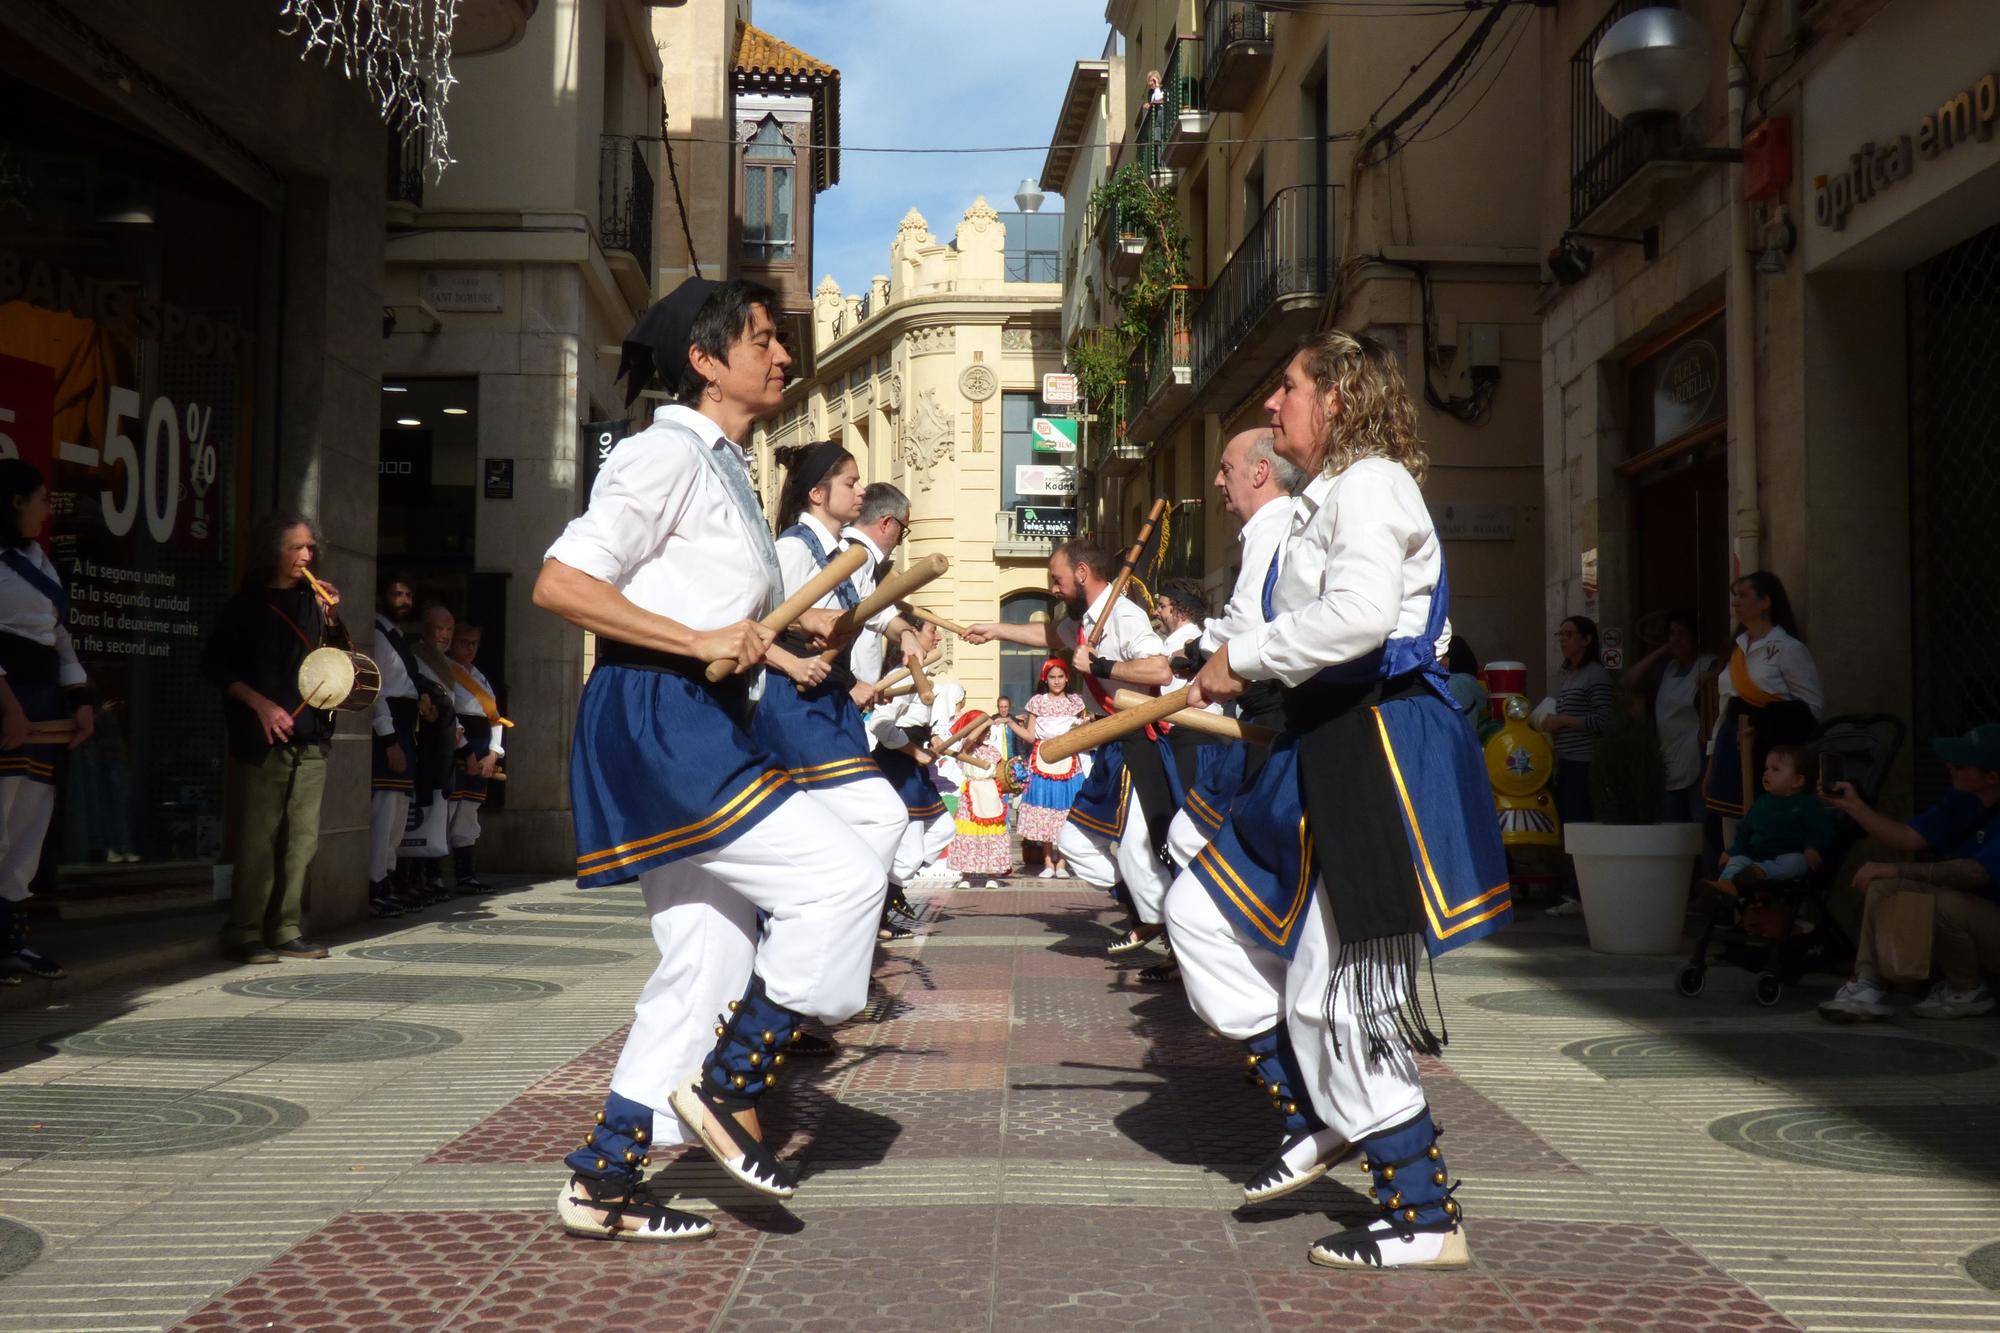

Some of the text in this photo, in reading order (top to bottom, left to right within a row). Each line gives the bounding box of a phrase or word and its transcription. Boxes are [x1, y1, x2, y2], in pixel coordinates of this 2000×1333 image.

[1045, 481, 1075, 491] Kodak
[72, 558, 177, 587] A la segona unitat
[70, 582, 191, 612] En la segunda unidad
[69, 608, 199, 636] Dans la deuxième unité
[83, 633, 104, 652] the
[106, 639, 146, 656] second
[149, 642, 171, 657] unit
